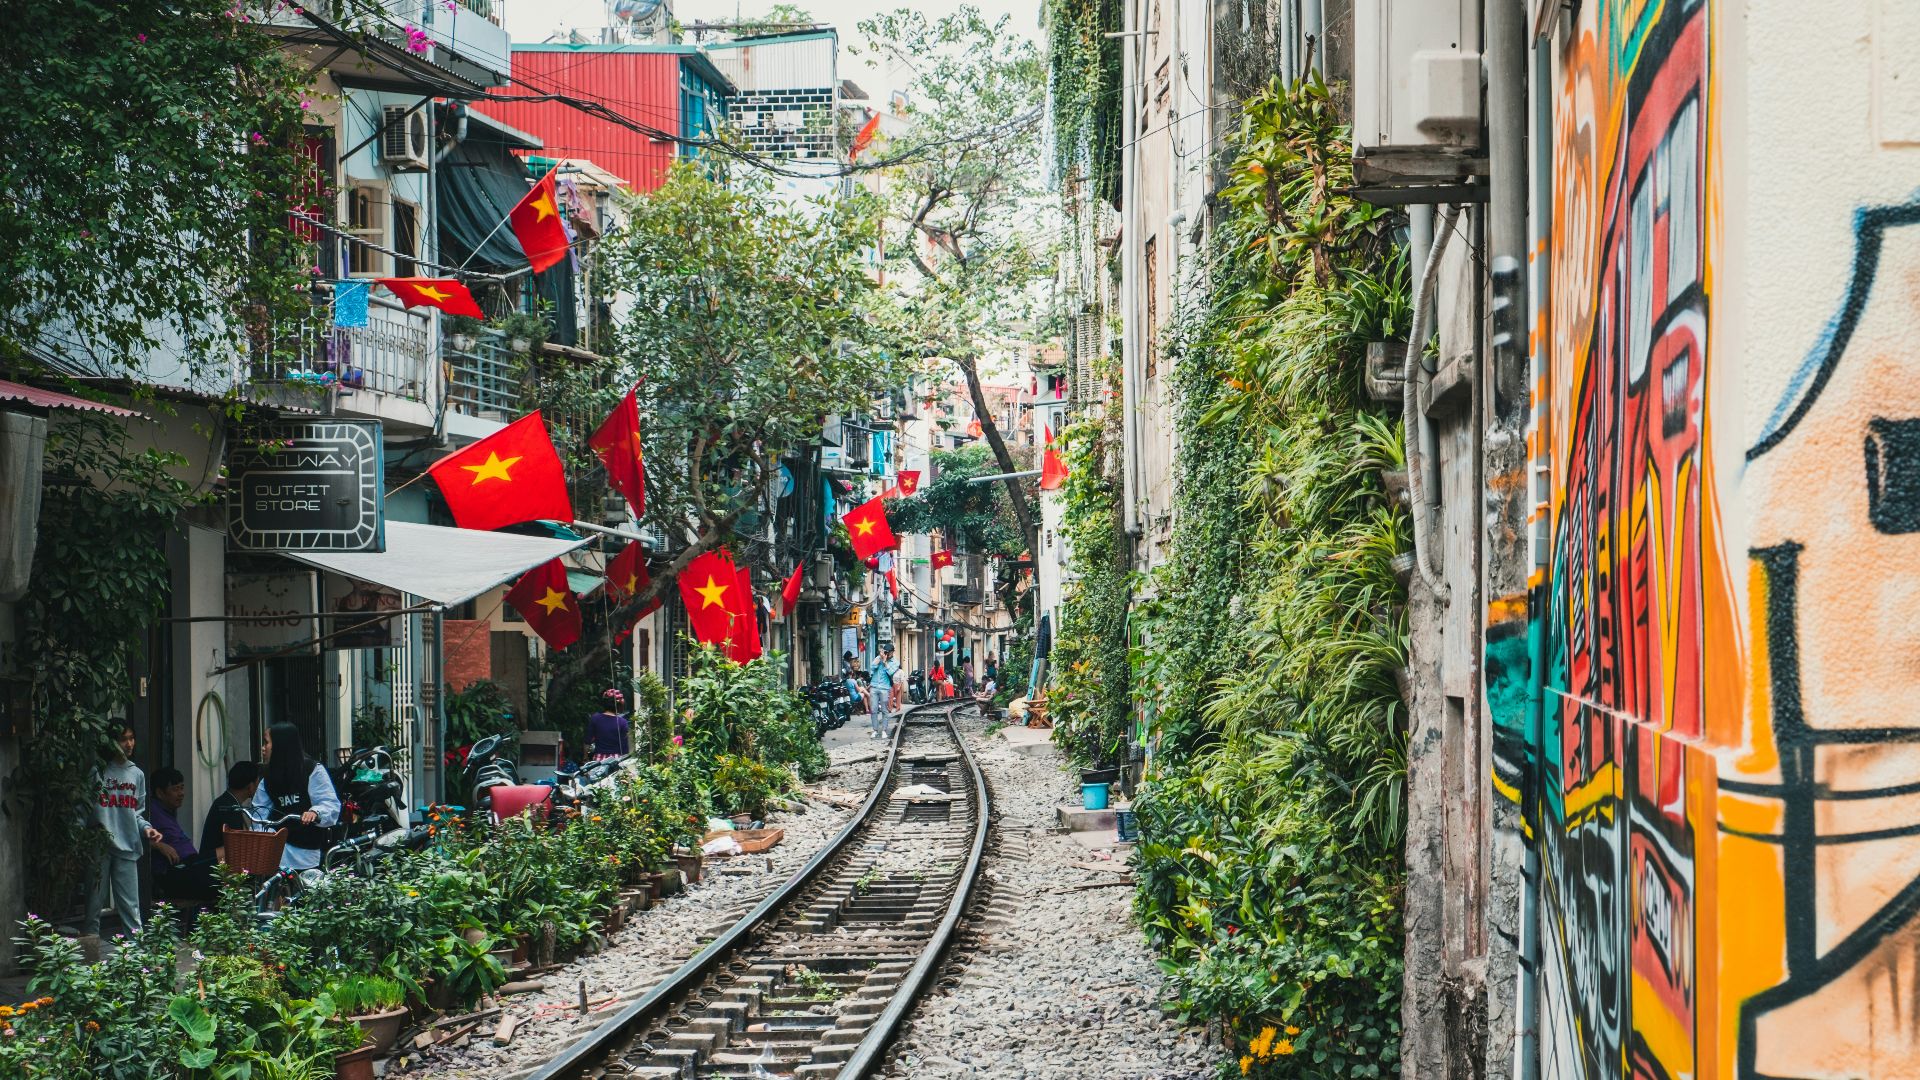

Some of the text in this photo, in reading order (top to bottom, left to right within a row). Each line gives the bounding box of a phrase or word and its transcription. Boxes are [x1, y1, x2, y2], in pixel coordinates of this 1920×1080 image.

[231, 454, 357, 467] RAILWAY
[255, 484, 331, 496] OUTFIT
[255, 500, 321, 511] STORE
[849, 611, 858, 620] 17
